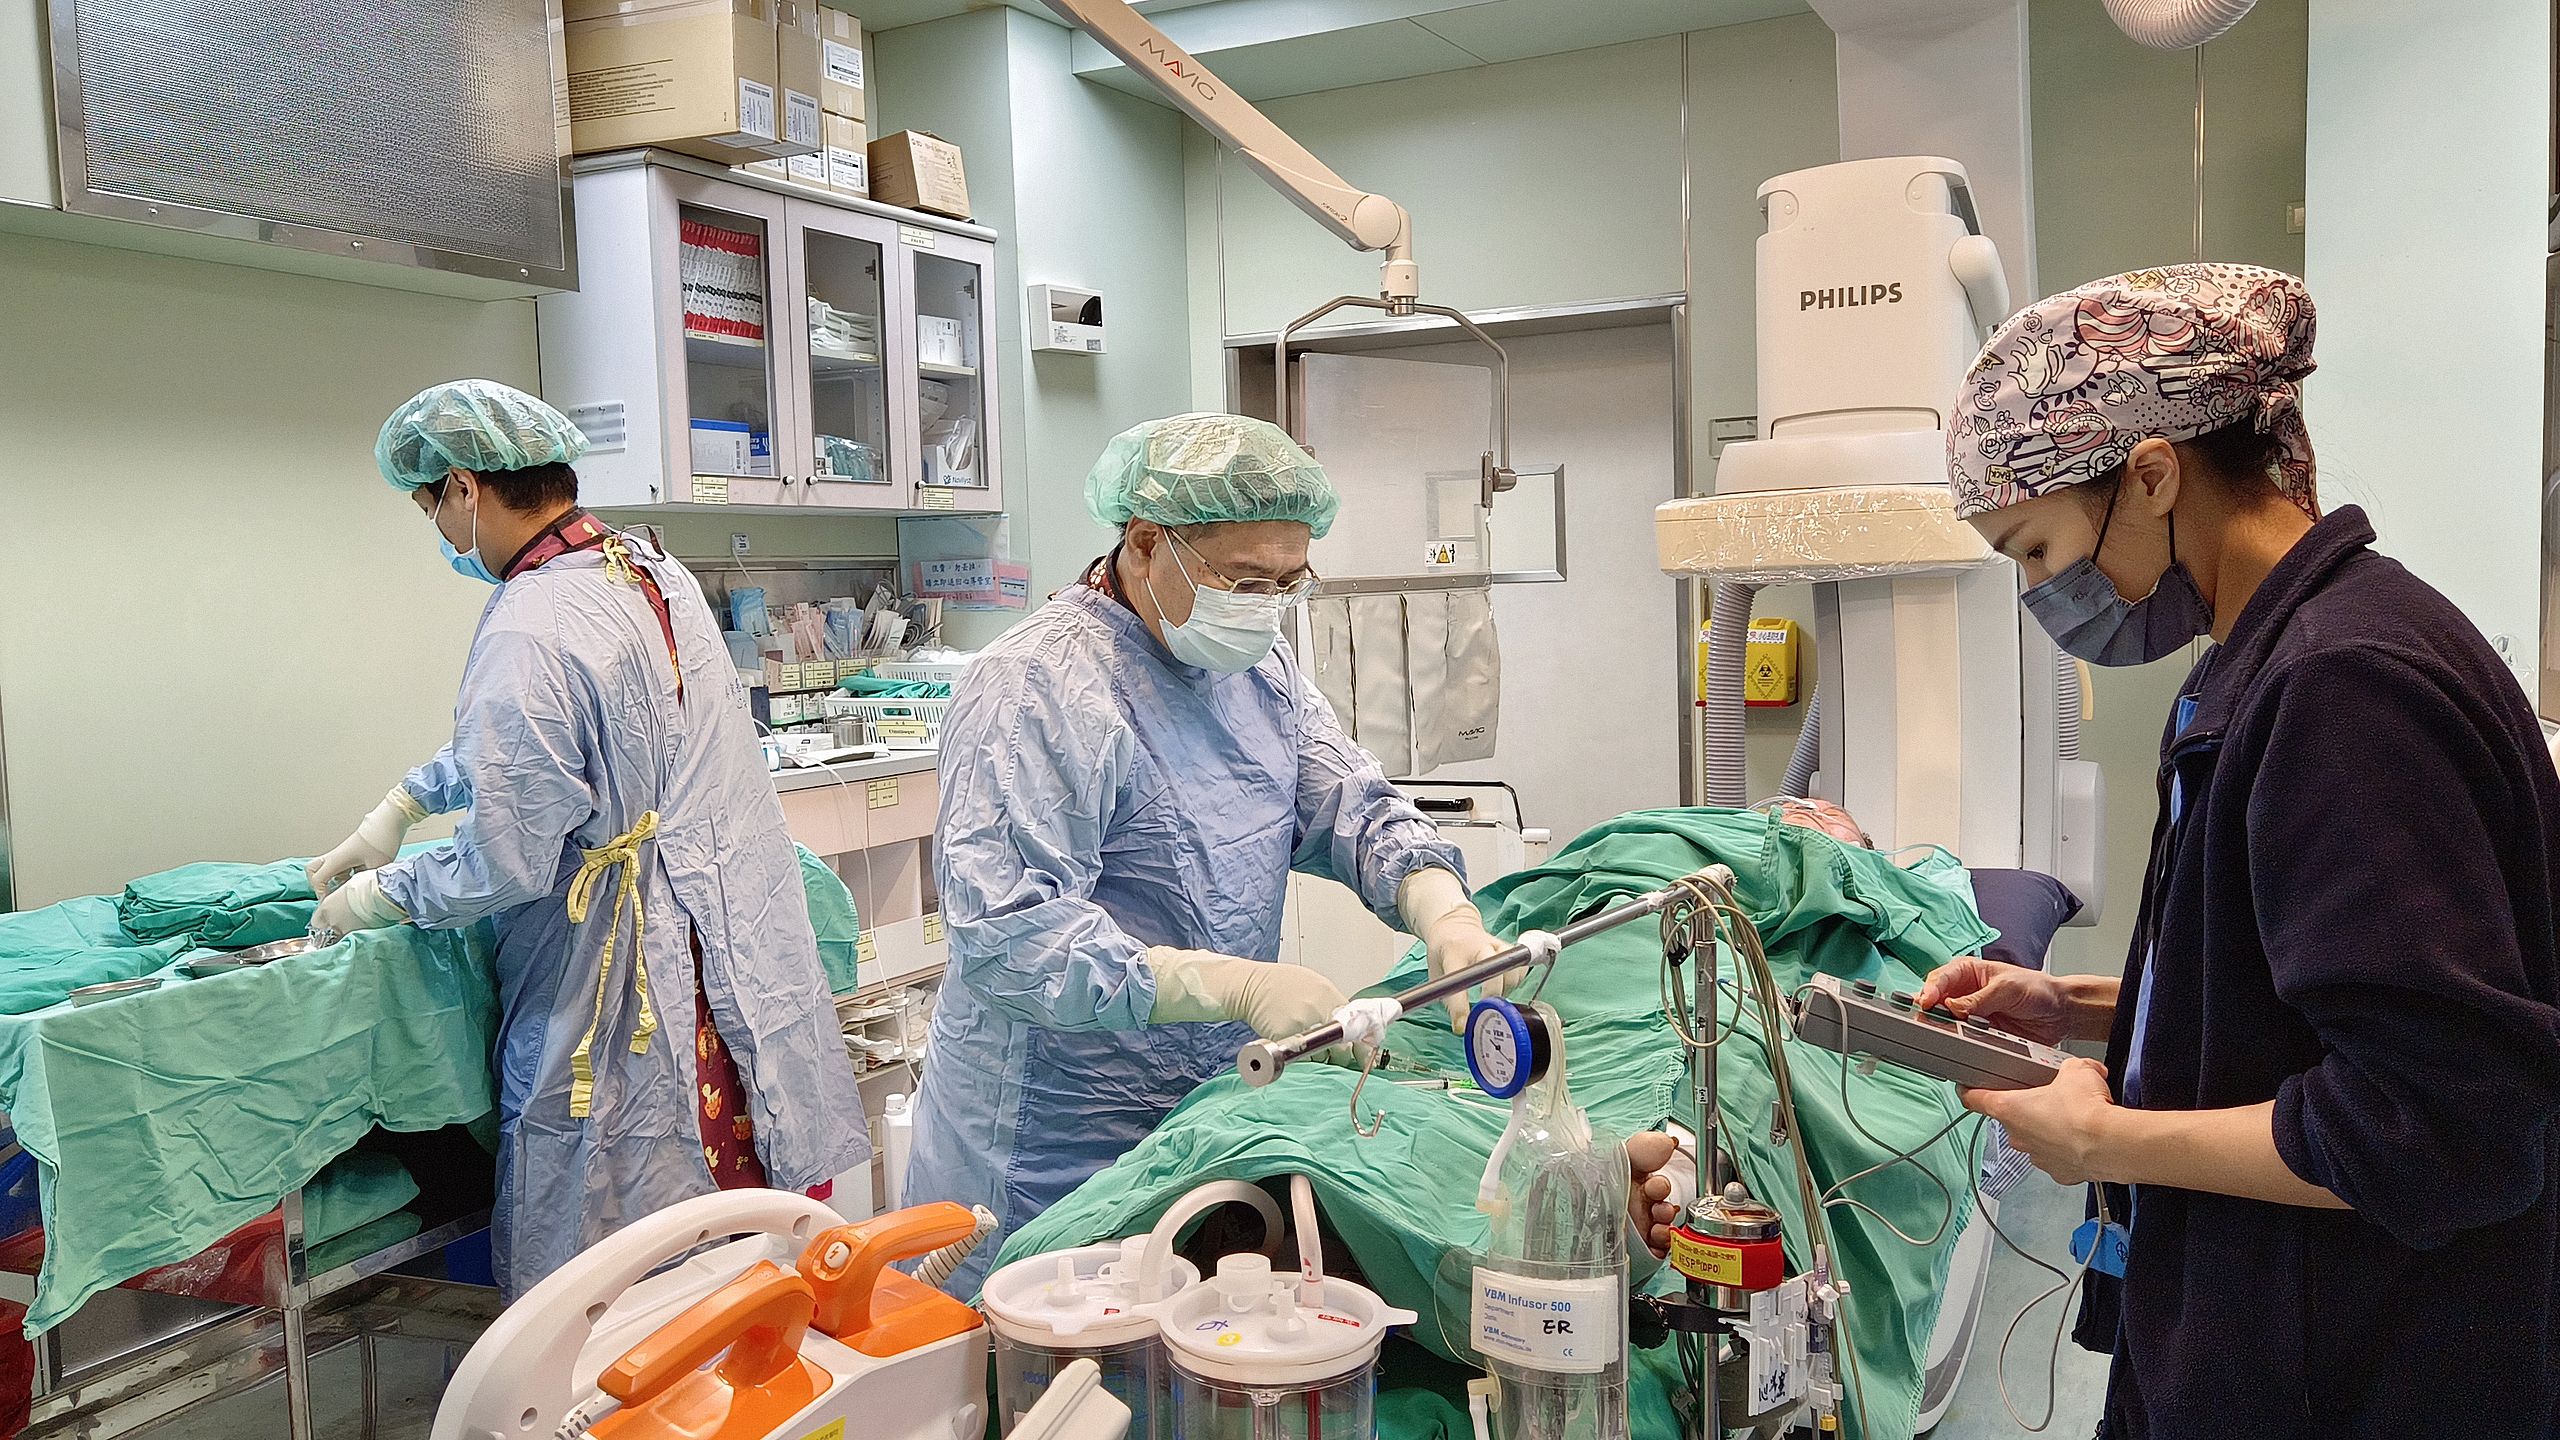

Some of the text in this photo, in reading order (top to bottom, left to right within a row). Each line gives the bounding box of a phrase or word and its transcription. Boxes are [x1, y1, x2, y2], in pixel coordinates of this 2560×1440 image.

[1139, 37, 1218, 102] MAVIG
[1799, 282, 1903, 311] PHILIPS
[1484, 1287, 1571, 1312] VBM Infusor 500
[1483, 1325, 1500, 1336] VBM
[1542, 1319, 1574, 1335] ER
